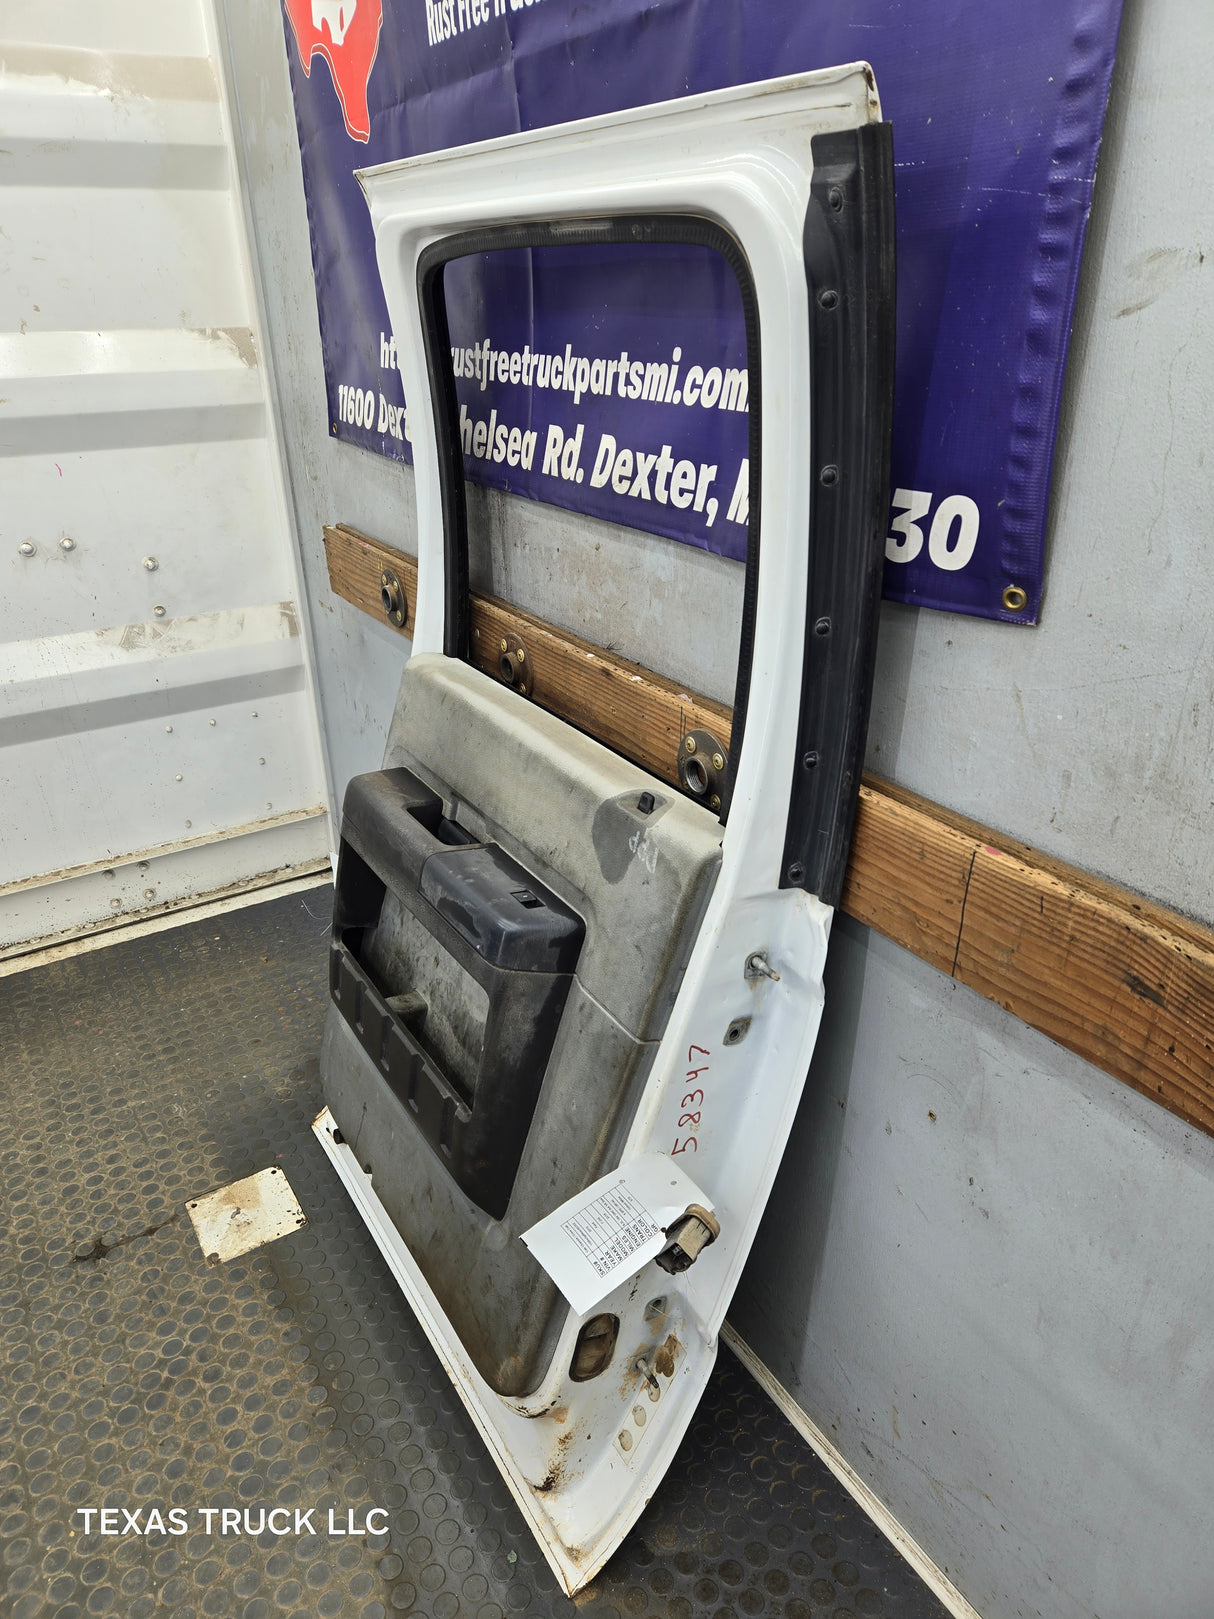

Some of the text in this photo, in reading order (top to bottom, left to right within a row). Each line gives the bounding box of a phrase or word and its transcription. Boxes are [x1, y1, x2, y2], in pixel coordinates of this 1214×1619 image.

[425, 0, 458, 47] Rust
[451, 338, 749, 413] ustfreetruckpartsmi.com
[338, 384, 375, 430] 11600
[542, 423, 585, 484] Rd.
[590, 433, 719, 527] Dexter,
[671, 1044, 710, 1156] 58347
[625, 1227, 641, 1247] ENGINE
[632, 1224, 647, 1242] TRANS
[637, 1218, 653, 1237] COLOR
[610, 1245, 623, 1261] MAKE
[614, 1237, 629, 1256] MODEL
[621, 1235, 635, 1252] MILES
[604, 1250, 617, 1266] YEAR
